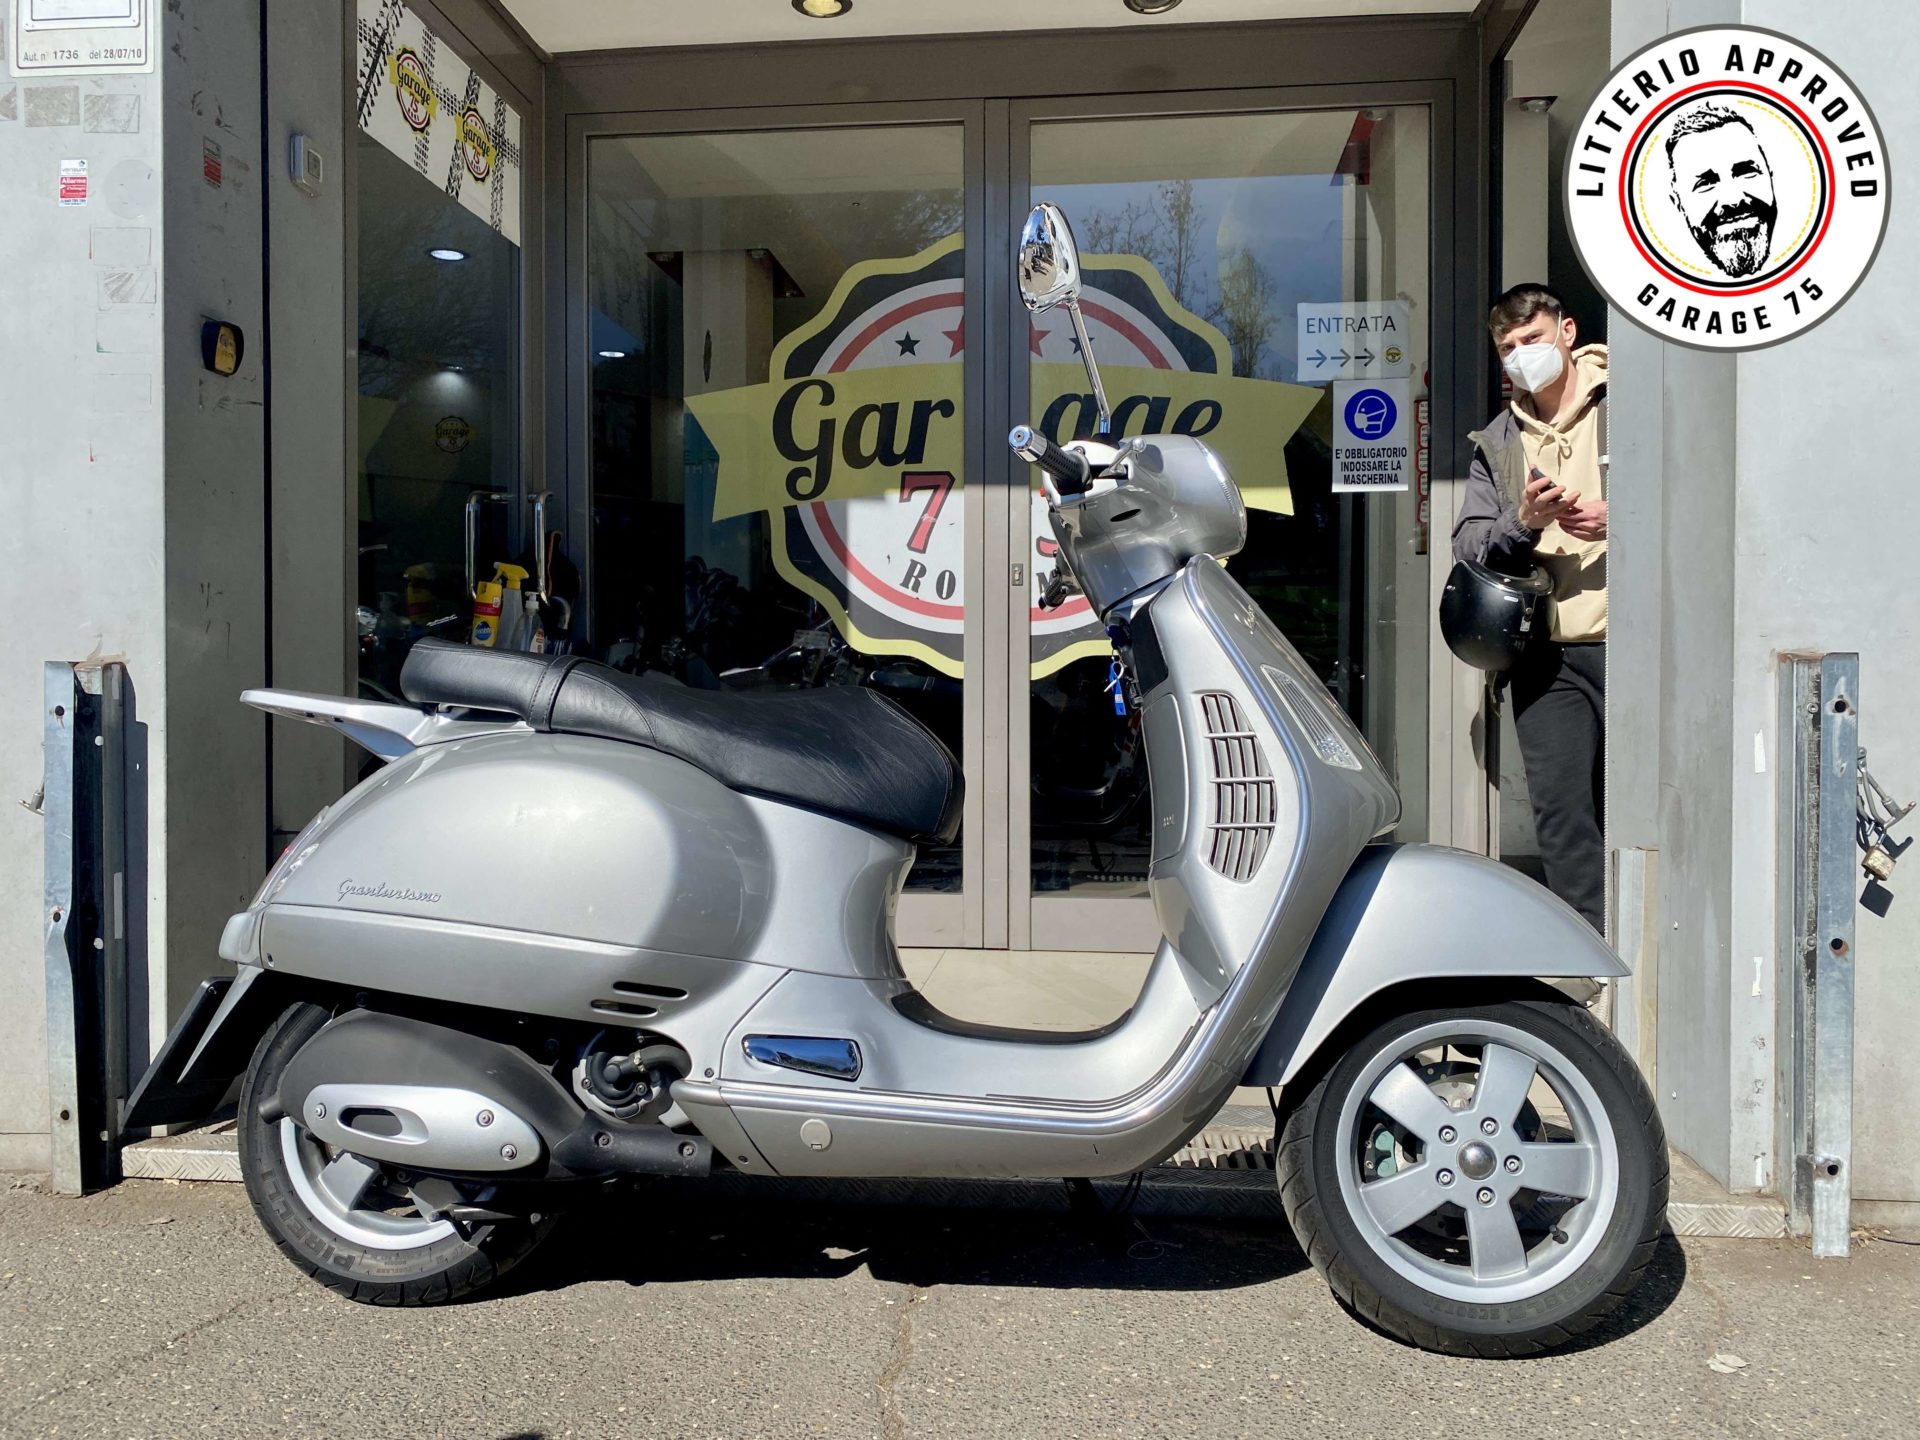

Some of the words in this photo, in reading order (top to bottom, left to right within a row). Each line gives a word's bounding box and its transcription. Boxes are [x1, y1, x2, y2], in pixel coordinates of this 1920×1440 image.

[23, 51, 39, 62] Aut.
[52, 49, 79, 60] 1736
[88, 49, 100, 60] del
[103, 48, 142, 59] 28/07/10
[397, 63, 431, 106] Garage
[409, 92, 419, 113] 75
[462, 119, 491, 157] Garage
[472, 144, 482, 165] 75
[1306, 315, 1397, 334] ENTRATA
[1335, 447, 1344, 460] E'
[1344, 446, 1408, 460] OBBLIGATORIO
[1340, 460, 1389, 473] INDOSSARE
[1390, 459, 1402, 472] LA
[1343, 472, 1399, 486] MASCHERINA
[338, 879, 442, 903] Granturismo
[260, 1167, 357, 1273] PIRELLI
